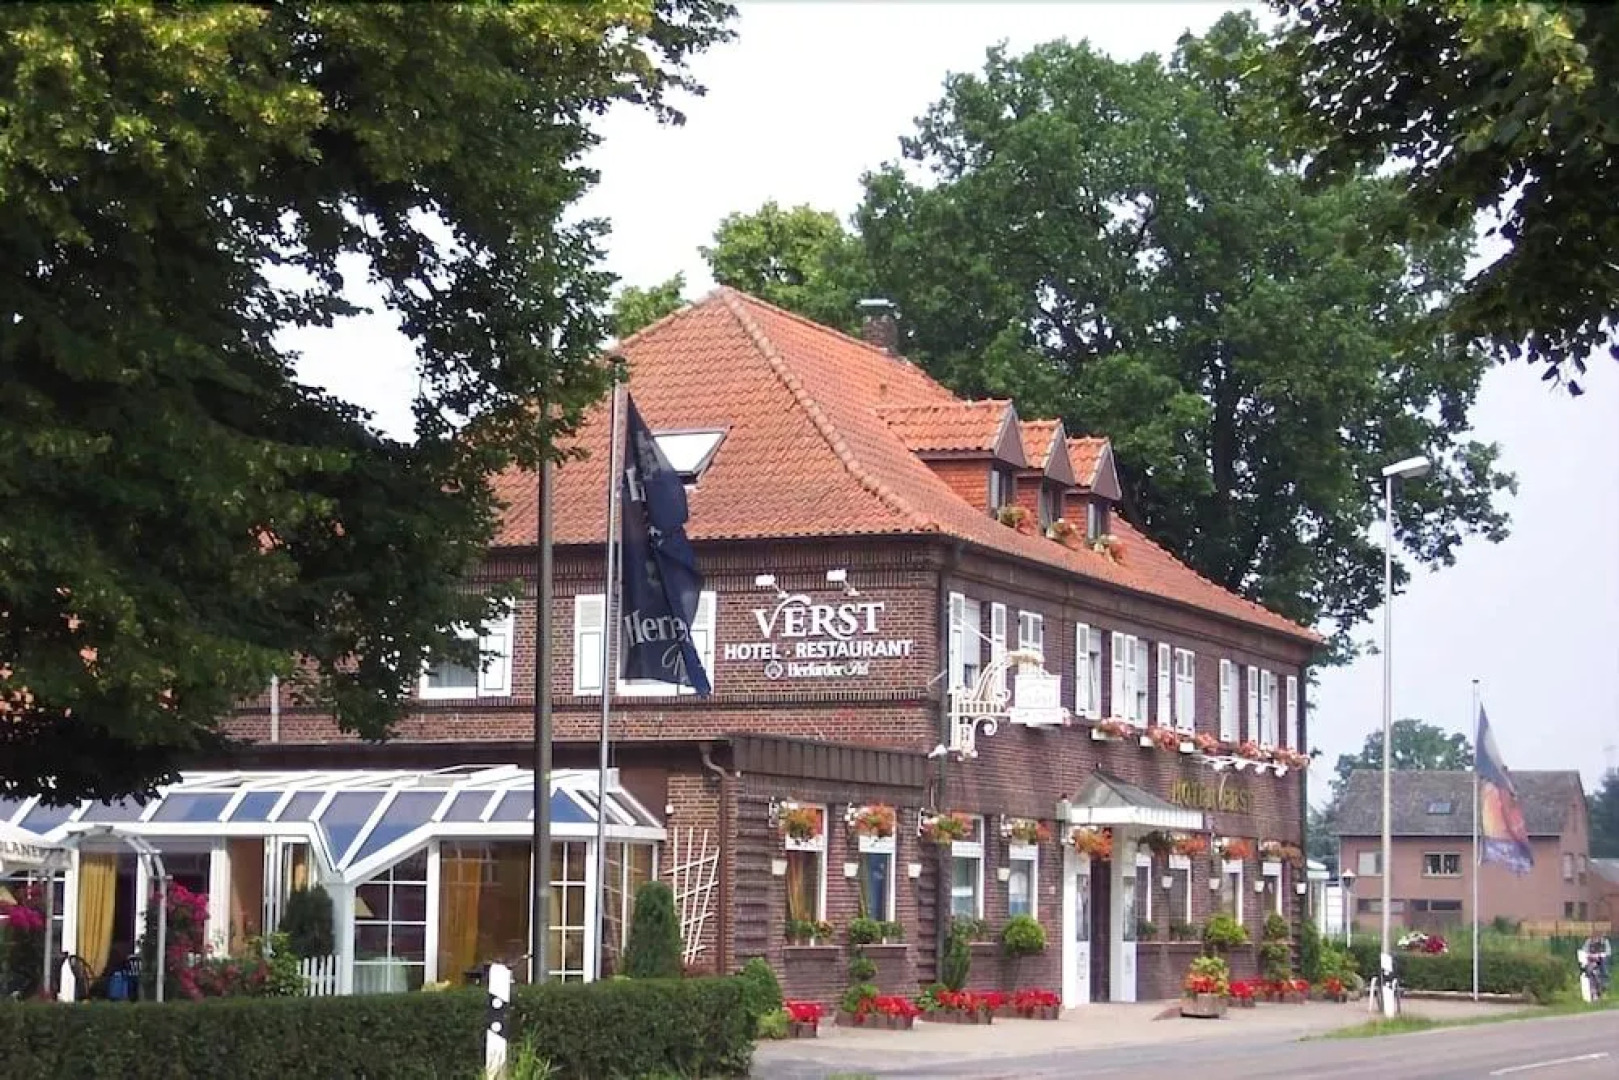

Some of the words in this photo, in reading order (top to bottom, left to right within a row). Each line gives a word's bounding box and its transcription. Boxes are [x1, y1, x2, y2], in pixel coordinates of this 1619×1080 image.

[752, 594, 885, 641] VERST
[724, 642, 782, 660] HOTEL
[795, 638, 914, 659] RESTAURANT
